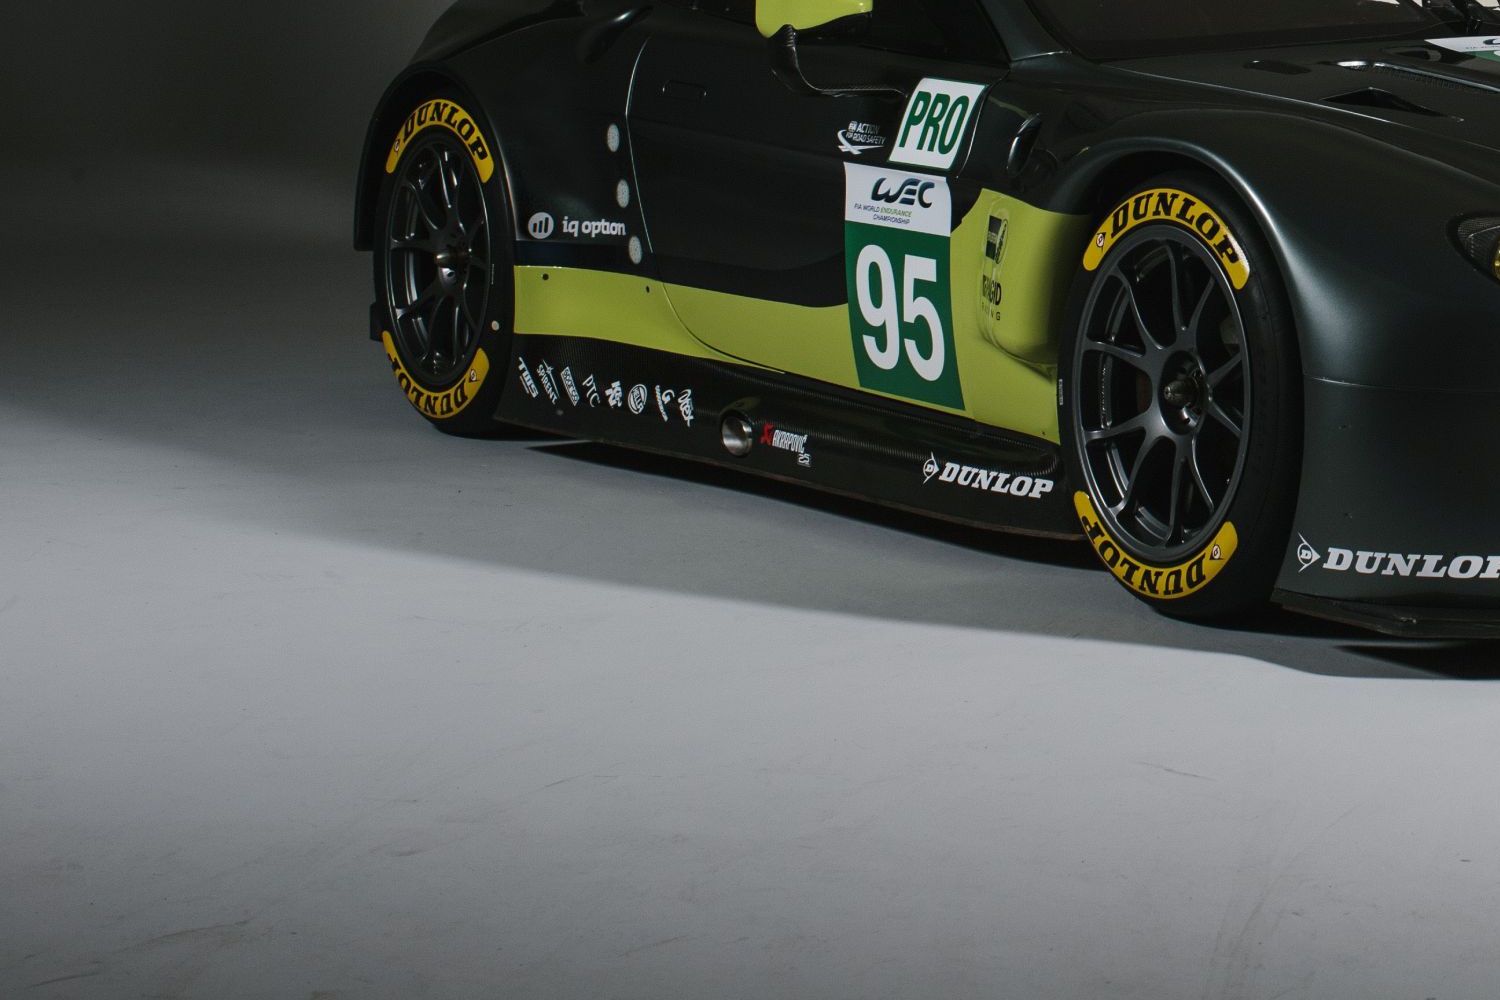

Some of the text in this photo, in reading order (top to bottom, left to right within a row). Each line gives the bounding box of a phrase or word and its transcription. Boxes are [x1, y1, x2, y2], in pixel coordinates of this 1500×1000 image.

[403, 102, 488, 161] DUNLOP
[866, 135, 886, 145] SAFETY
[898, 91, 970, 155] PRO
[871, 178, 935, 209] WEC
[880, 206, 912, 217] ENDURANCE
[562, 216, 627, 238] iq option
[1111, 192, 1239, 264] DUNLOP
[856, 244, 945, 382] 95
[387, 353, 469, 416] DUNLOP
[939, 462, 1054, 499] DUNLOP
[1081, 516, 1207, 596] DUNLOP
